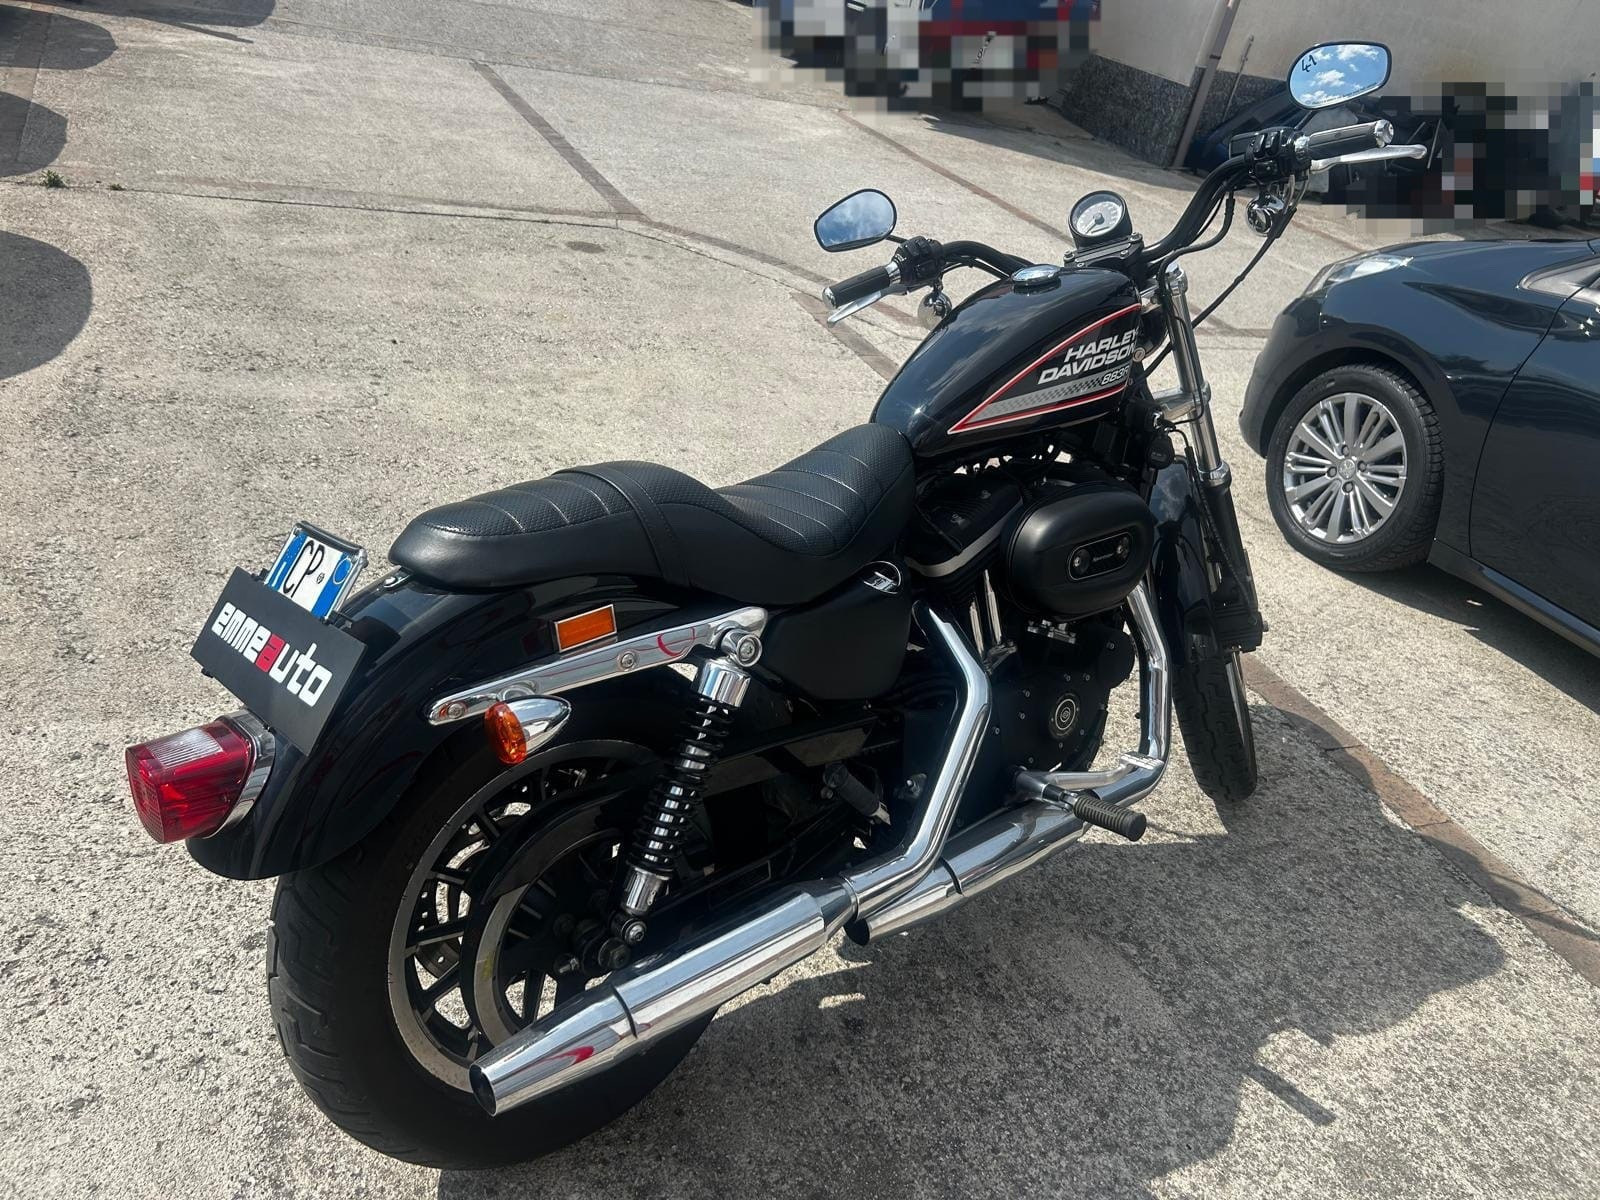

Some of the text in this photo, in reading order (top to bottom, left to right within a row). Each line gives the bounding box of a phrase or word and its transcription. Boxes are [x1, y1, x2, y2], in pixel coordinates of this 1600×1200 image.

[1038, 343, 1135, 384] DAVIDSON
[1064, 326, 1139, 363] HARLEY
[283, 540, 325, 598] CP
